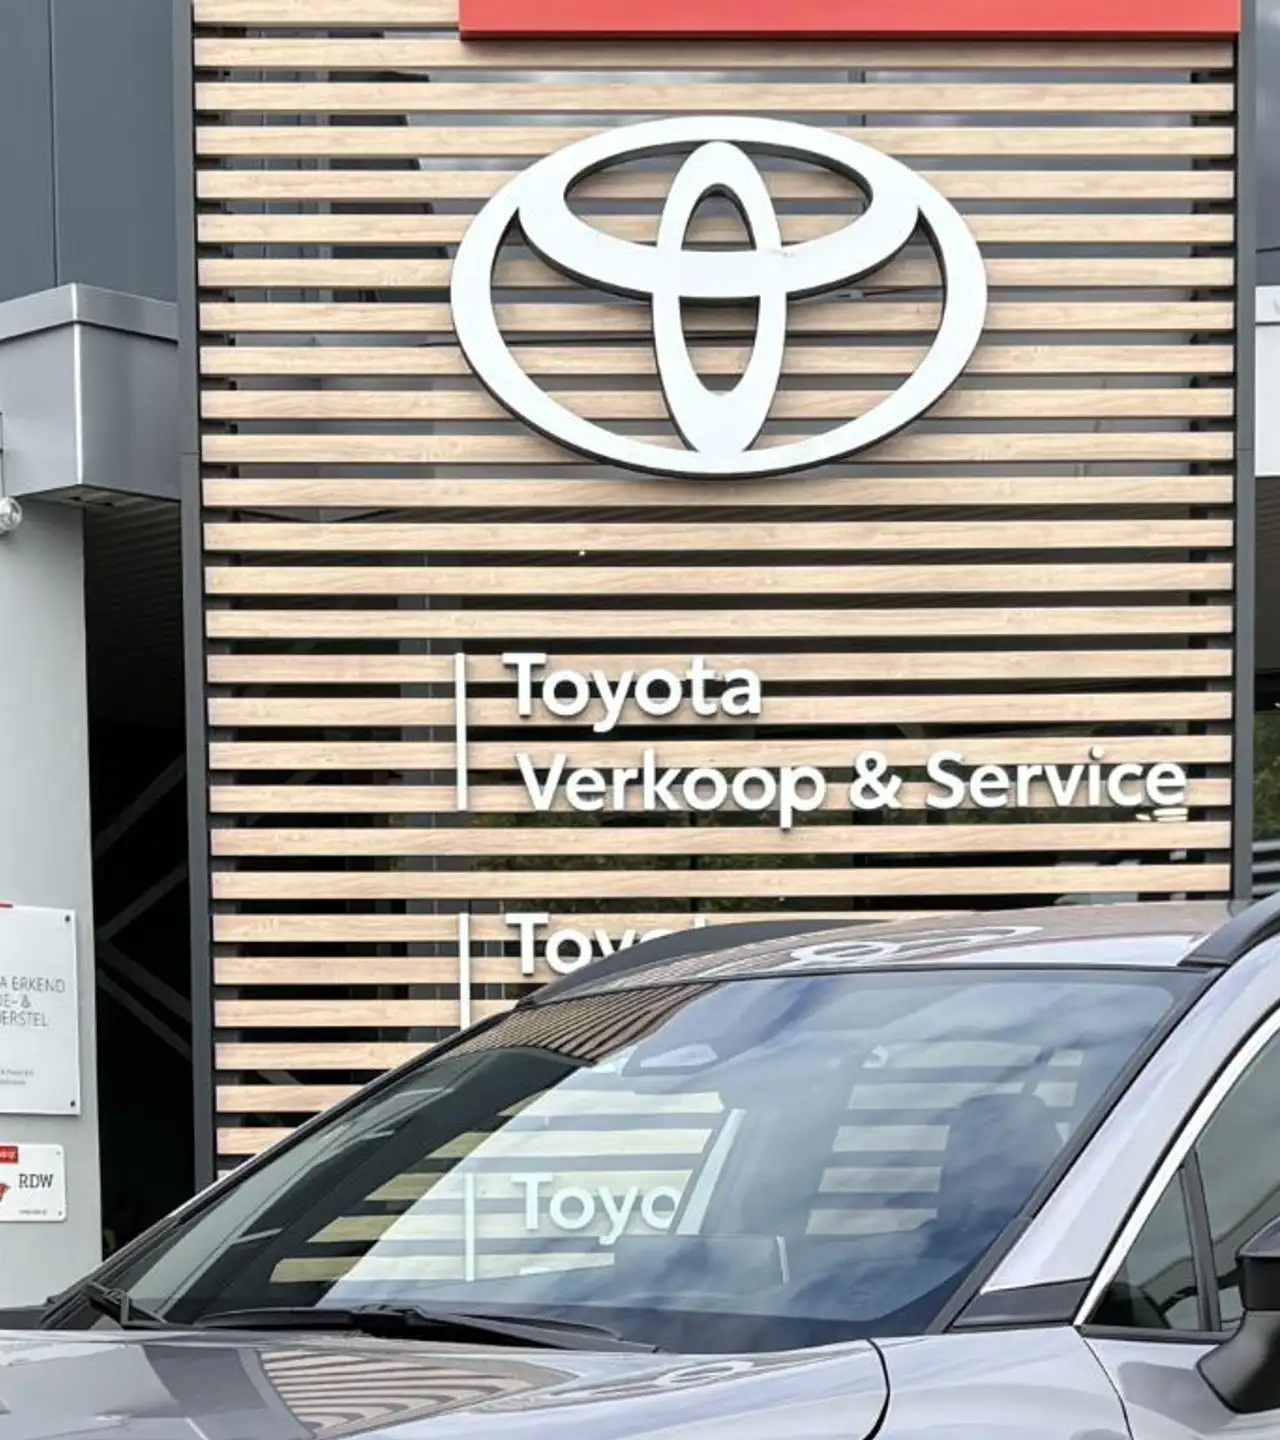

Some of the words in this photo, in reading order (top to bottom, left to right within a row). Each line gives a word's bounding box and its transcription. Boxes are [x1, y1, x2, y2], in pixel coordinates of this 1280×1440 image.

[503, 652, 762, 733] Toyota
[516, 747, 827, 830] Verkoop
[849, 753, 903, 810] &
[925, 745, 1188, 809] Service
[11, 975, 66, 993] ERKEND
[20, 993, 31, 1009] &
[18, 1173, 54, 1189] RDW
[510, 1173, 684, 1246] Toyo
